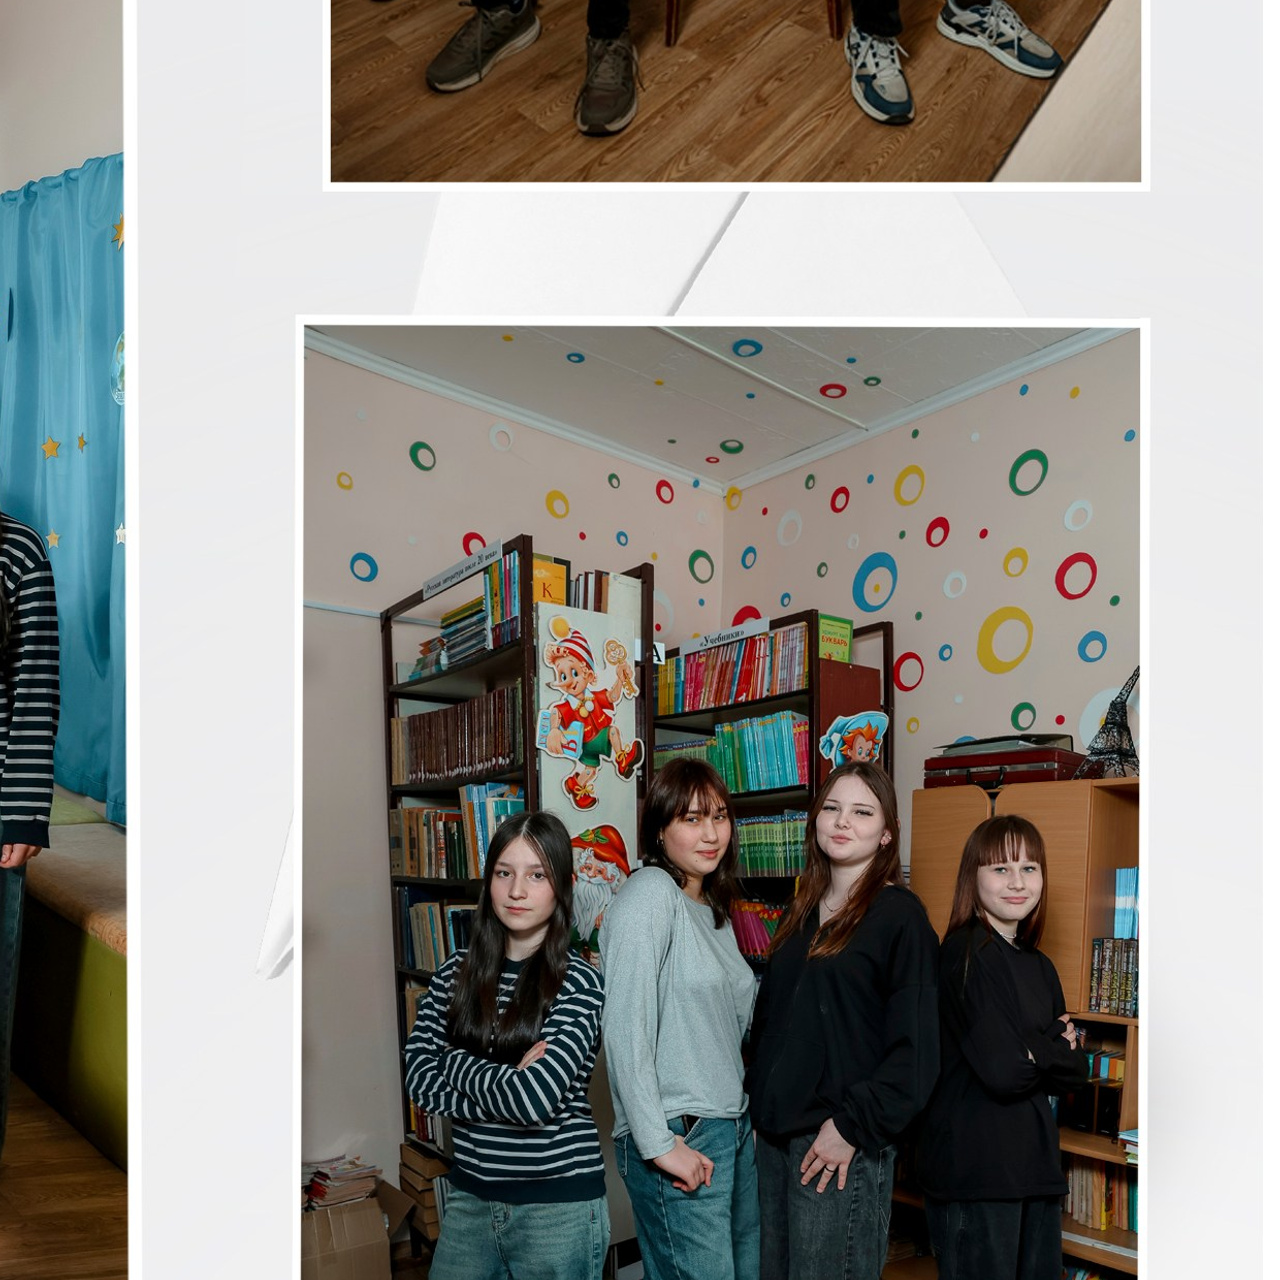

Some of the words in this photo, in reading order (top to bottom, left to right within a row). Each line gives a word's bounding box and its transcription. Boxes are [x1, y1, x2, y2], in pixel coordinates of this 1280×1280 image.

[542, 582, 553, 599] К
[700, 629, 745, 648] «Учебники»
[821, 634, 848, 647] БУКВАРЬ
